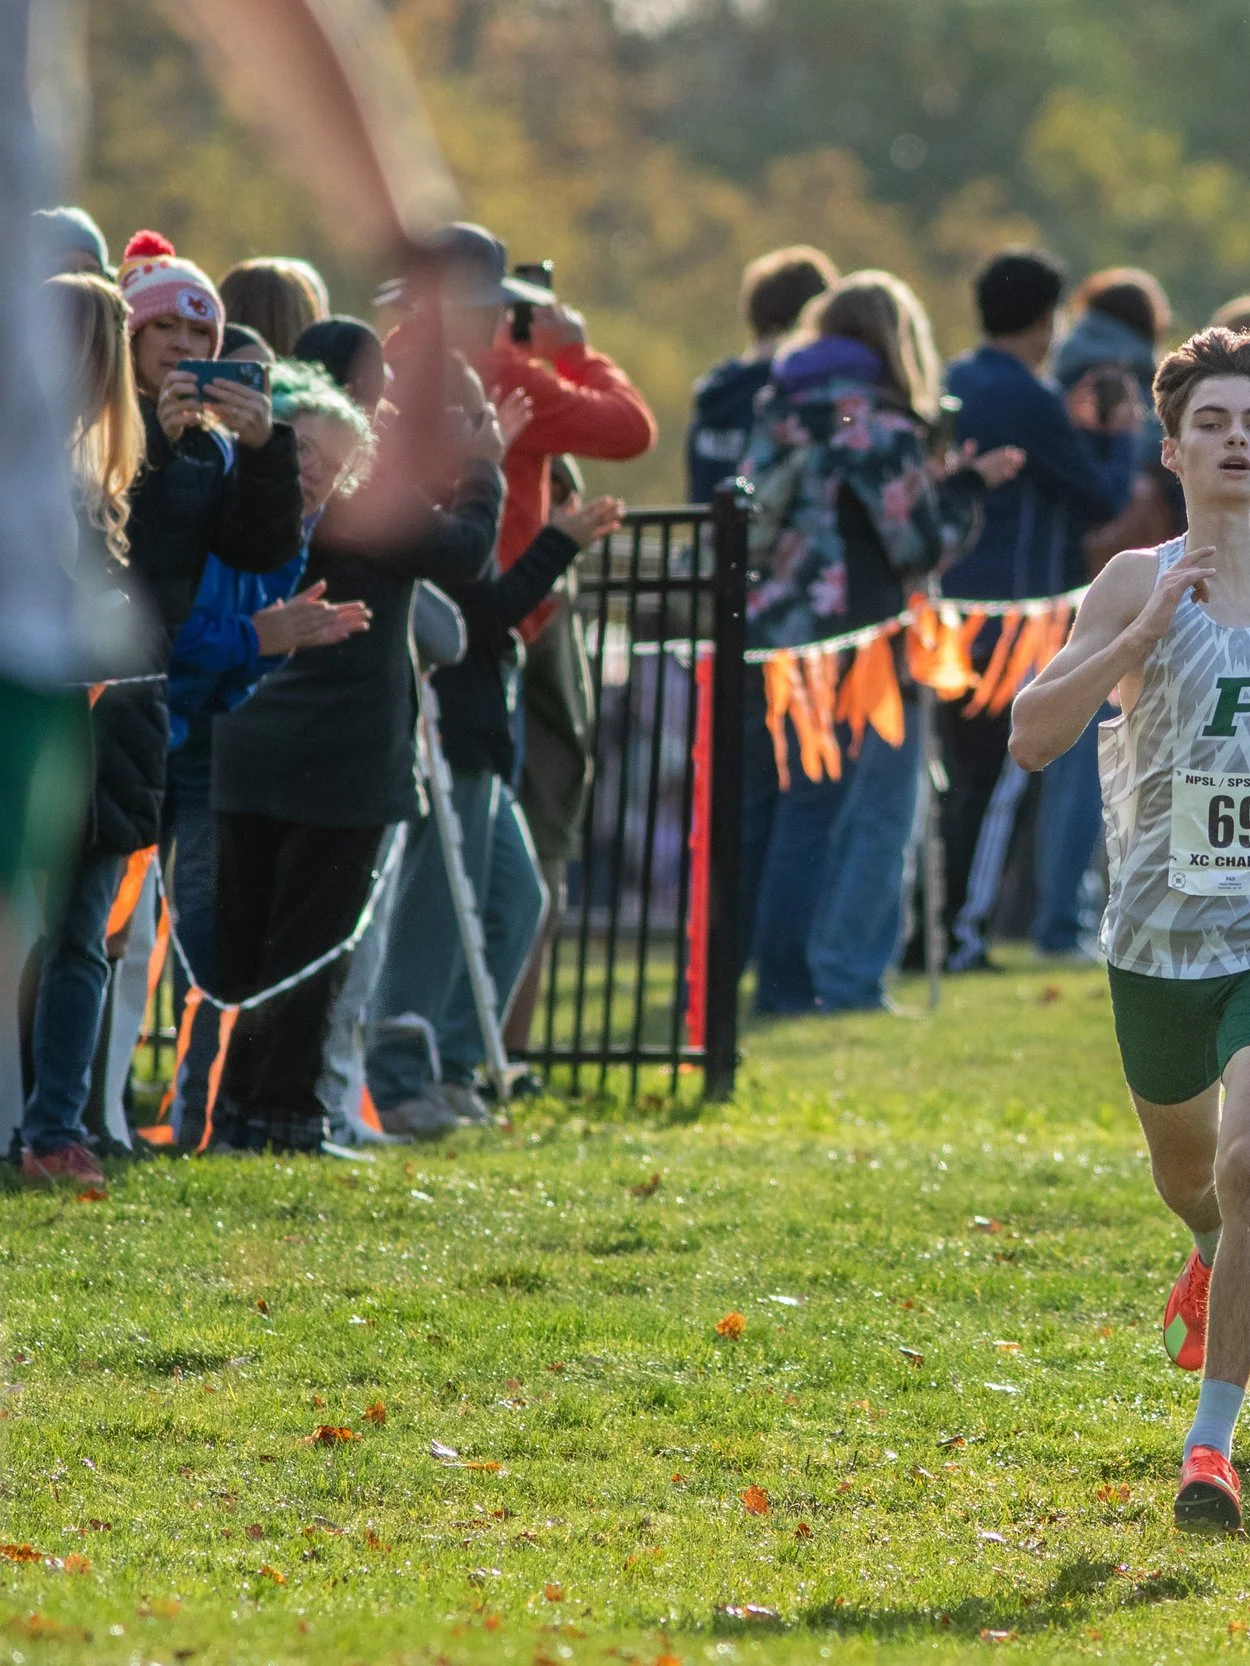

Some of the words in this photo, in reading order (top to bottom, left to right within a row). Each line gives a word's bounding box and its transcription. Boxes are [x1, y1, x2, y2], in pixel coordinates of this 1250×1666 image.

[1185, 775, 1217, 787] NPSL
[1218, 777, 1225, 788] /
[1189, 853, 1210, 867] XC
